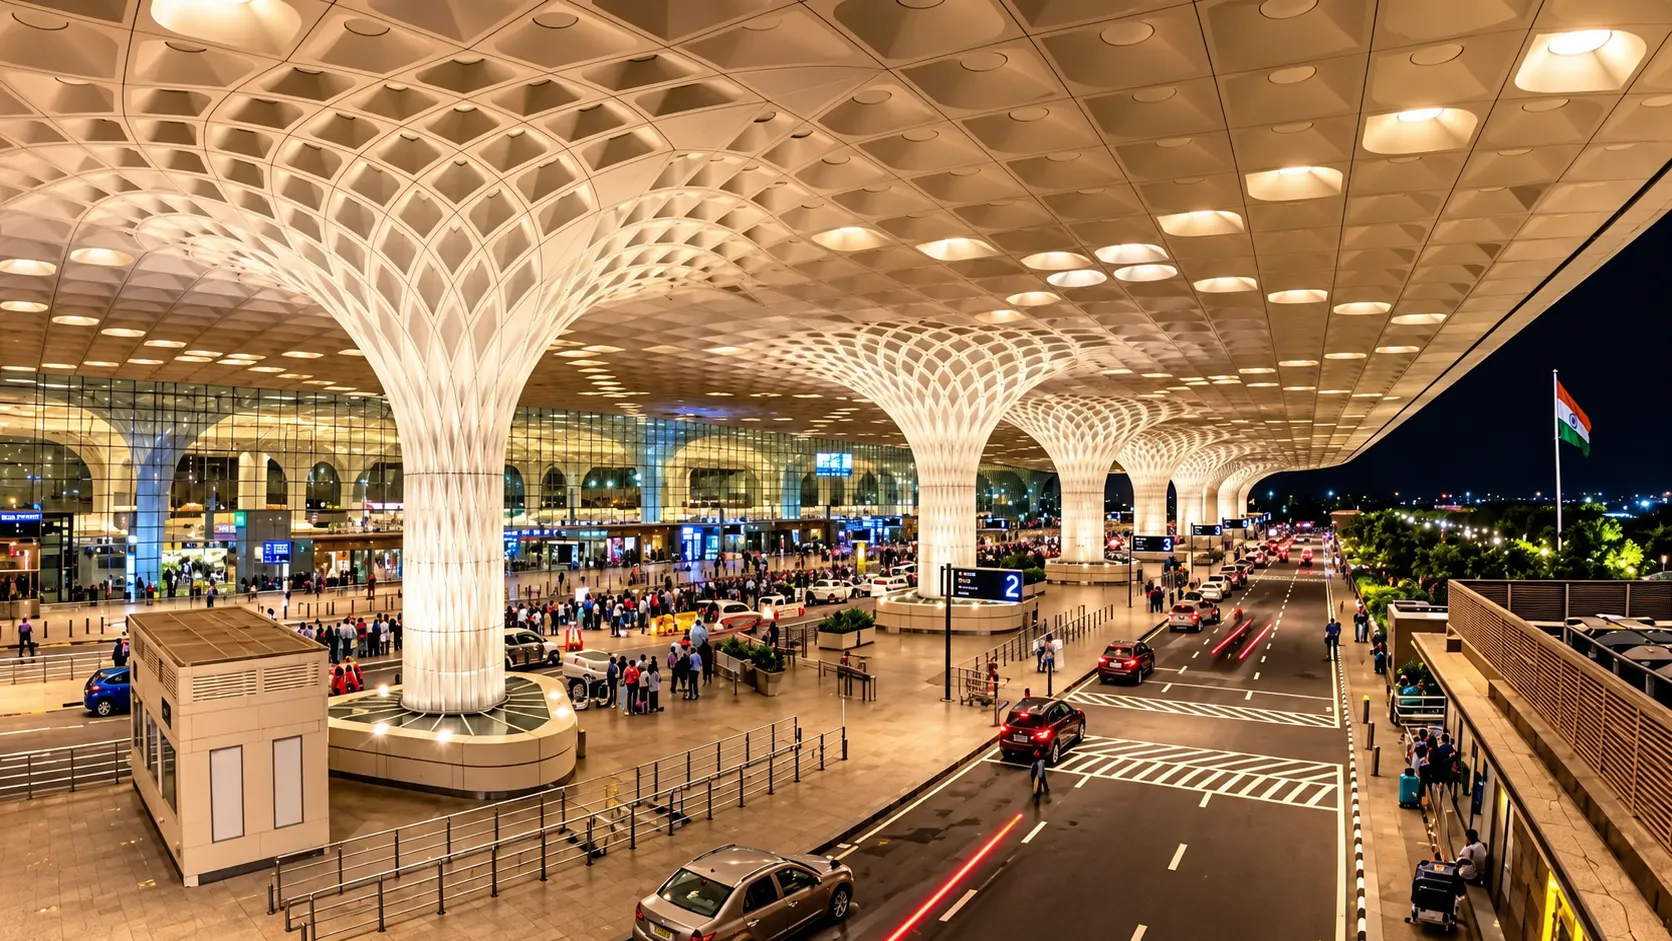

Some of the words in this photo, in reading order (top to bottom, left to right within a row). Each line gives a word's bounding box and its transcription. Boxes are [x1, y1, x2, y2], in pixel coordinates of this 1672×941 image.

[1214, 526, 1221, 535] 3
[1163, 538, 1171, 551] 3
[1005, 574, 1019, 598] 2
